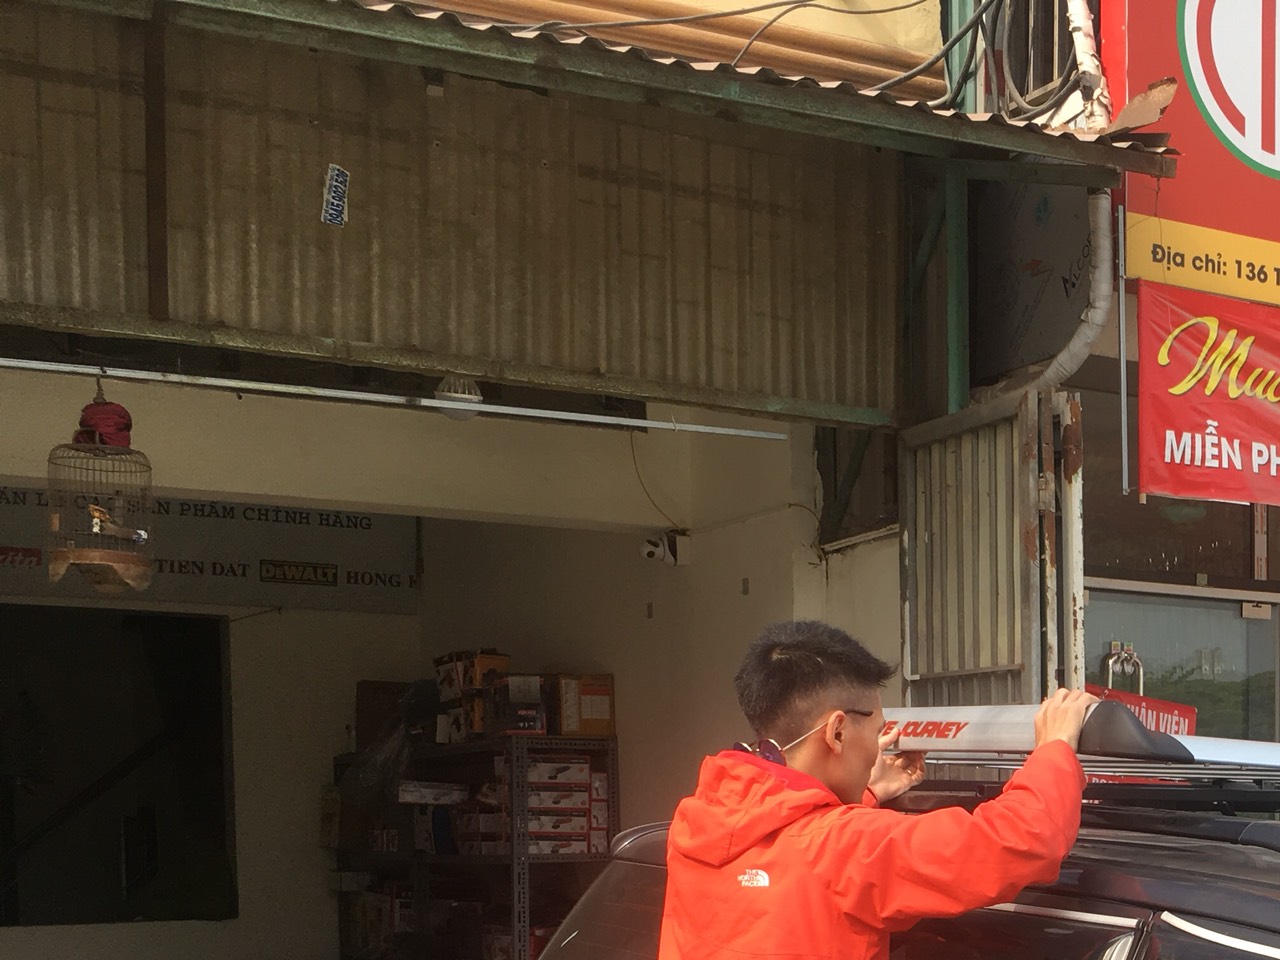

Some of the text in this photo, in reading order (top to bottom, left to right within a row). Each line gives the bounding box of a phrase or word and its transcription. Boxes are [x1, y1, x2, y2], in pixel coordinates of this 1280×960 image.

[1151, 243, 1186, 271] Địa
[1192, 252, 1228, 277] chỉ:
[1235, 259, 1269, 284] 136
[1163, 419, 1243, 471] MIỄN
[210, 561, 251, 578] DAT
[346, 571, 401, 588] HONG
[899, 720, 970, 739] JOURNEY
